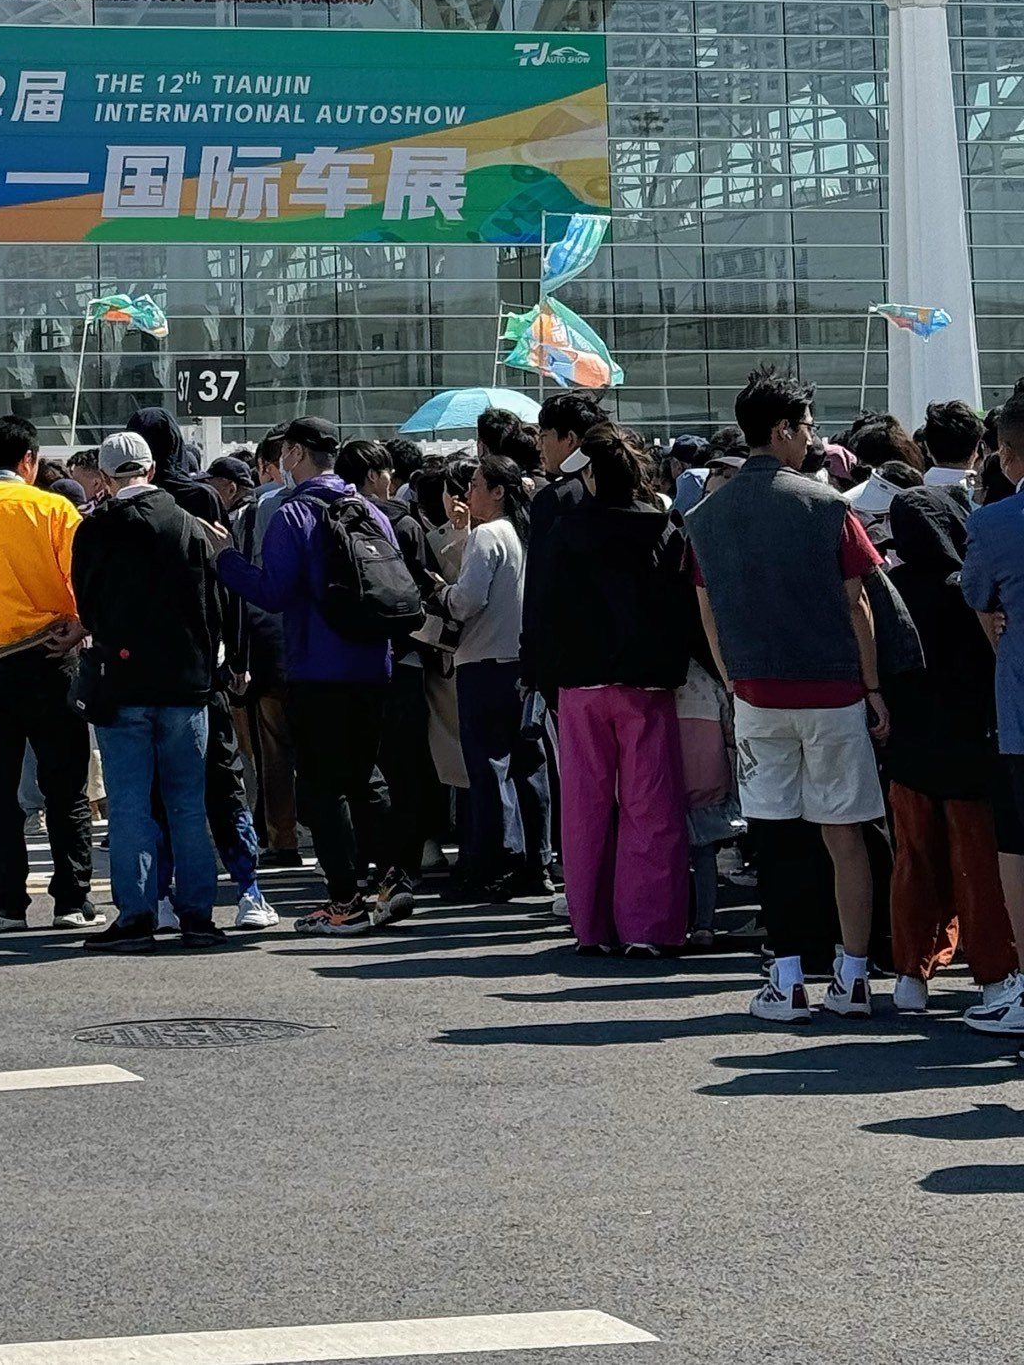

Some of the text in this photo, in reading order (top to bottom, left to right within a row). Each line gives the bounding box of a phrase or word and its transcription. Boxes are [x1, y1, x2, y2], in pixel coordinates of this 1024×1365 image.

[514, 42, 550, 66] TJ
[546, 56, 591, 64] AUTO SHOW
[95, 71, 311, 97] THE 12th TIANJIN
[94, 103, 466, 126] INTERNATIONAL AUTOSHOW
[177, 370, 190, 401] 37
[198, 370, 239, 401] 37
[234, 401, 245, 414] C
